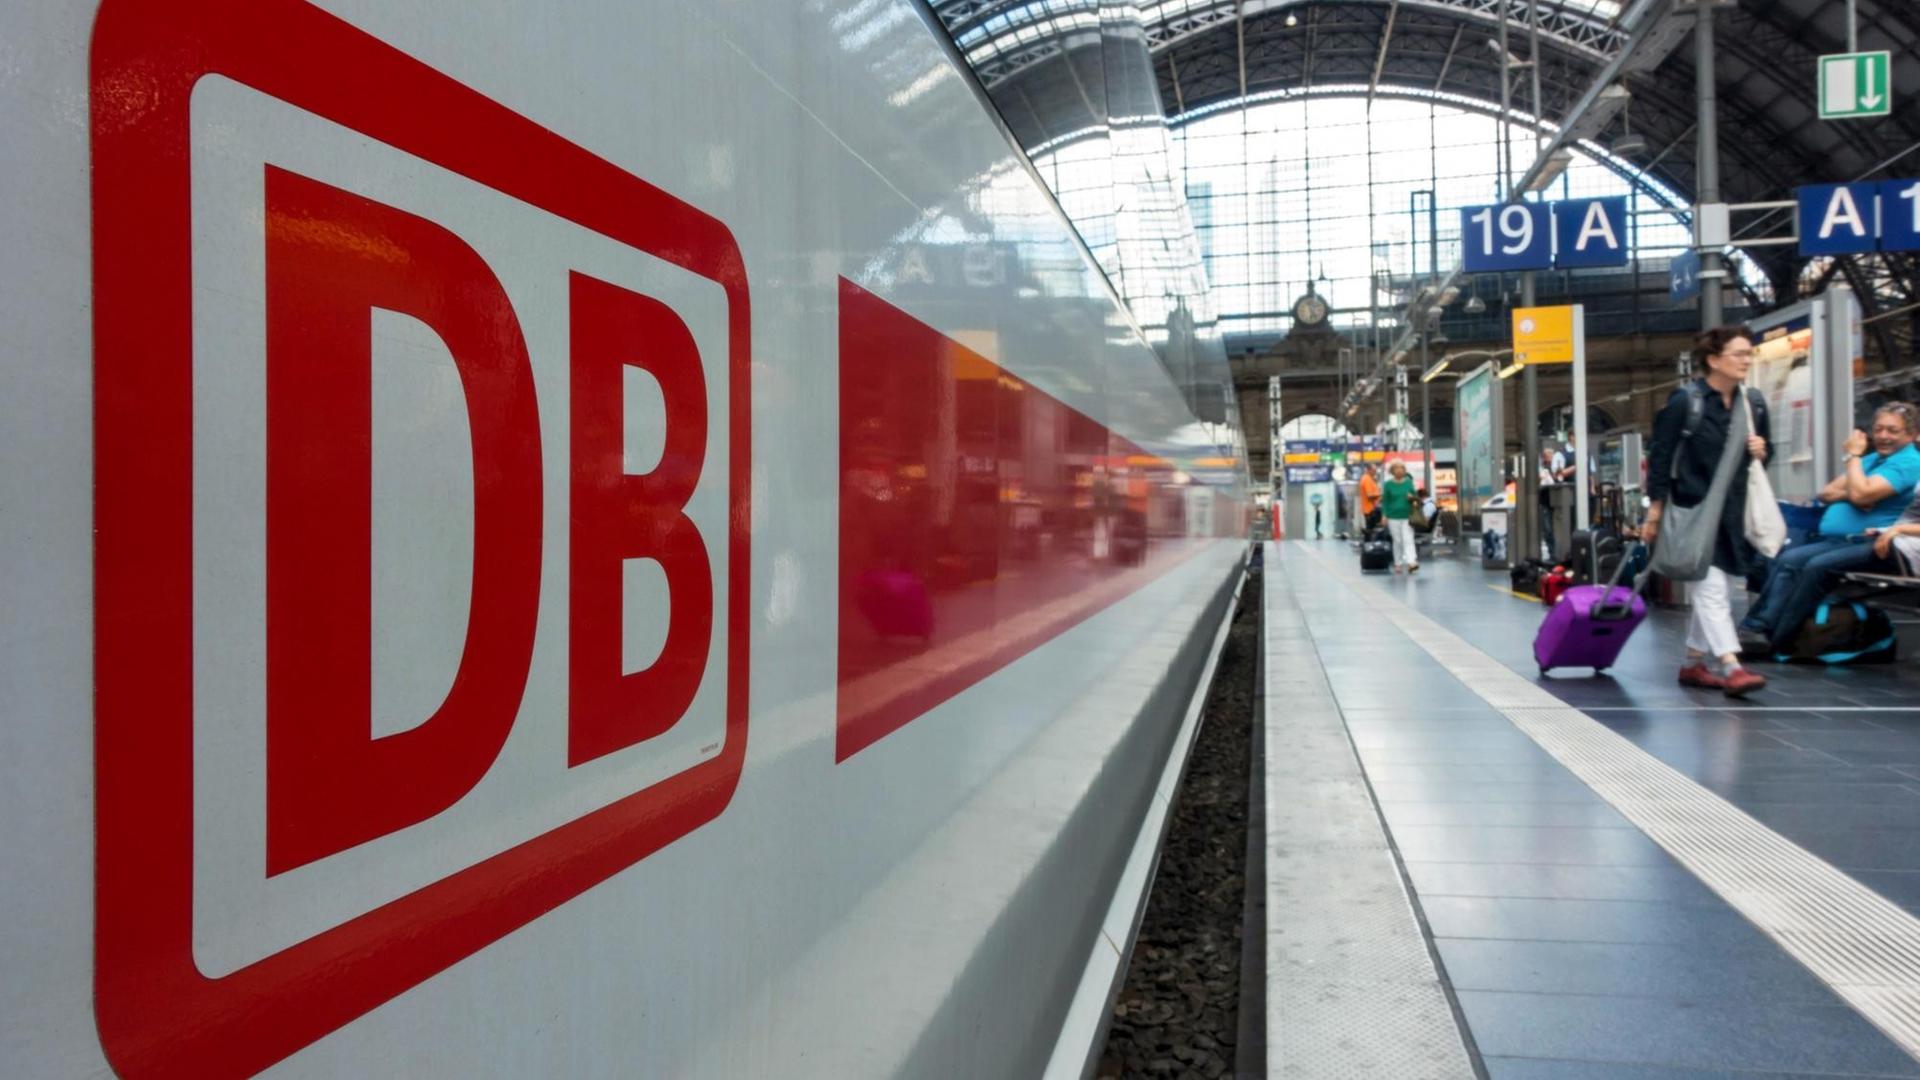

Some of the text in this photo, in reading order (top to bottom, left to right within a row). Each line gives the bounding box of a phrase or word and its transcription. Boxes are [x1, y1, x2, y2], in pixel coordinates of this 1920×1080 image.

[1471, 201, 1619, 256] 19 A
[1818, 186, 1865, 238] A
[265, 163, 713, 879] DB
